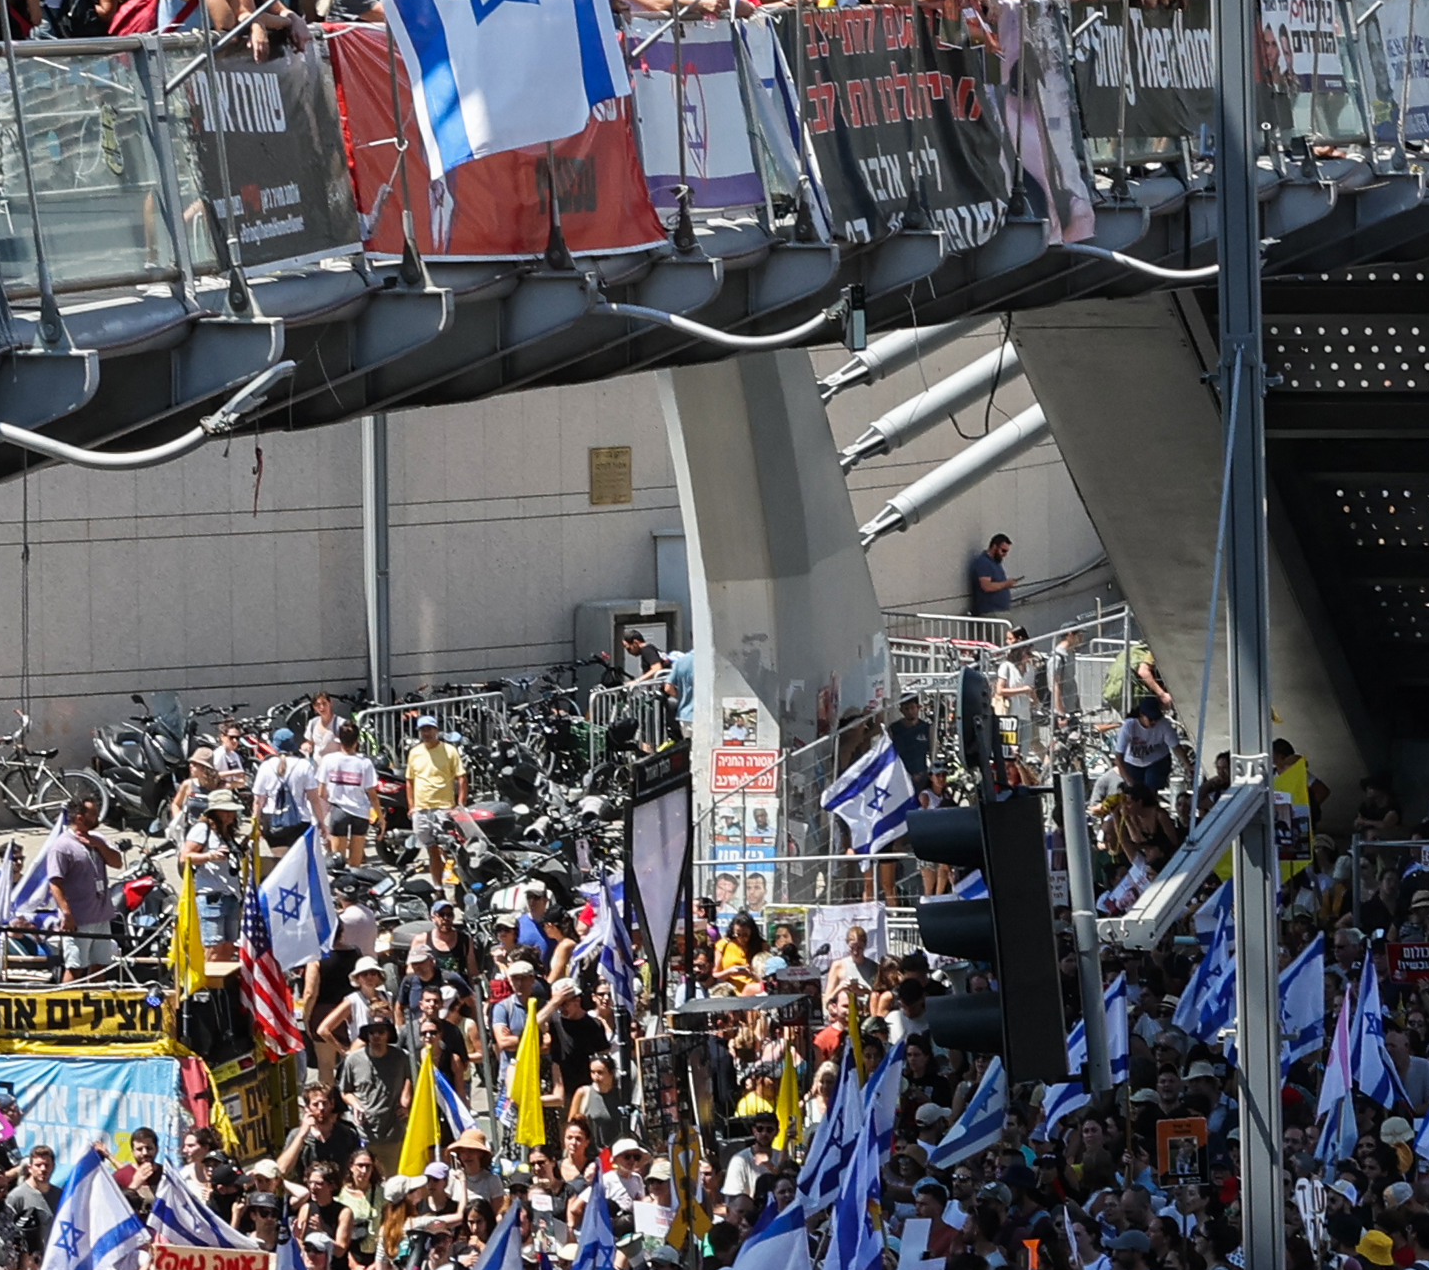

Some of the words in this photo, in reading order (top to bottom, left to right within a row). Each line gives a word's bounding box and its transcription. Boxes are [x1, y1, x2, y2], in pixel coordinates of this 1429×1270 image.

[1174, 7, 1215, 89] Hom
[190, 70, 236, 132] אתי
[717, 754, 745, 768] החניה
[746, 754, 775, 768] אסורה
[46, 987, 165, 1034] מצילים
